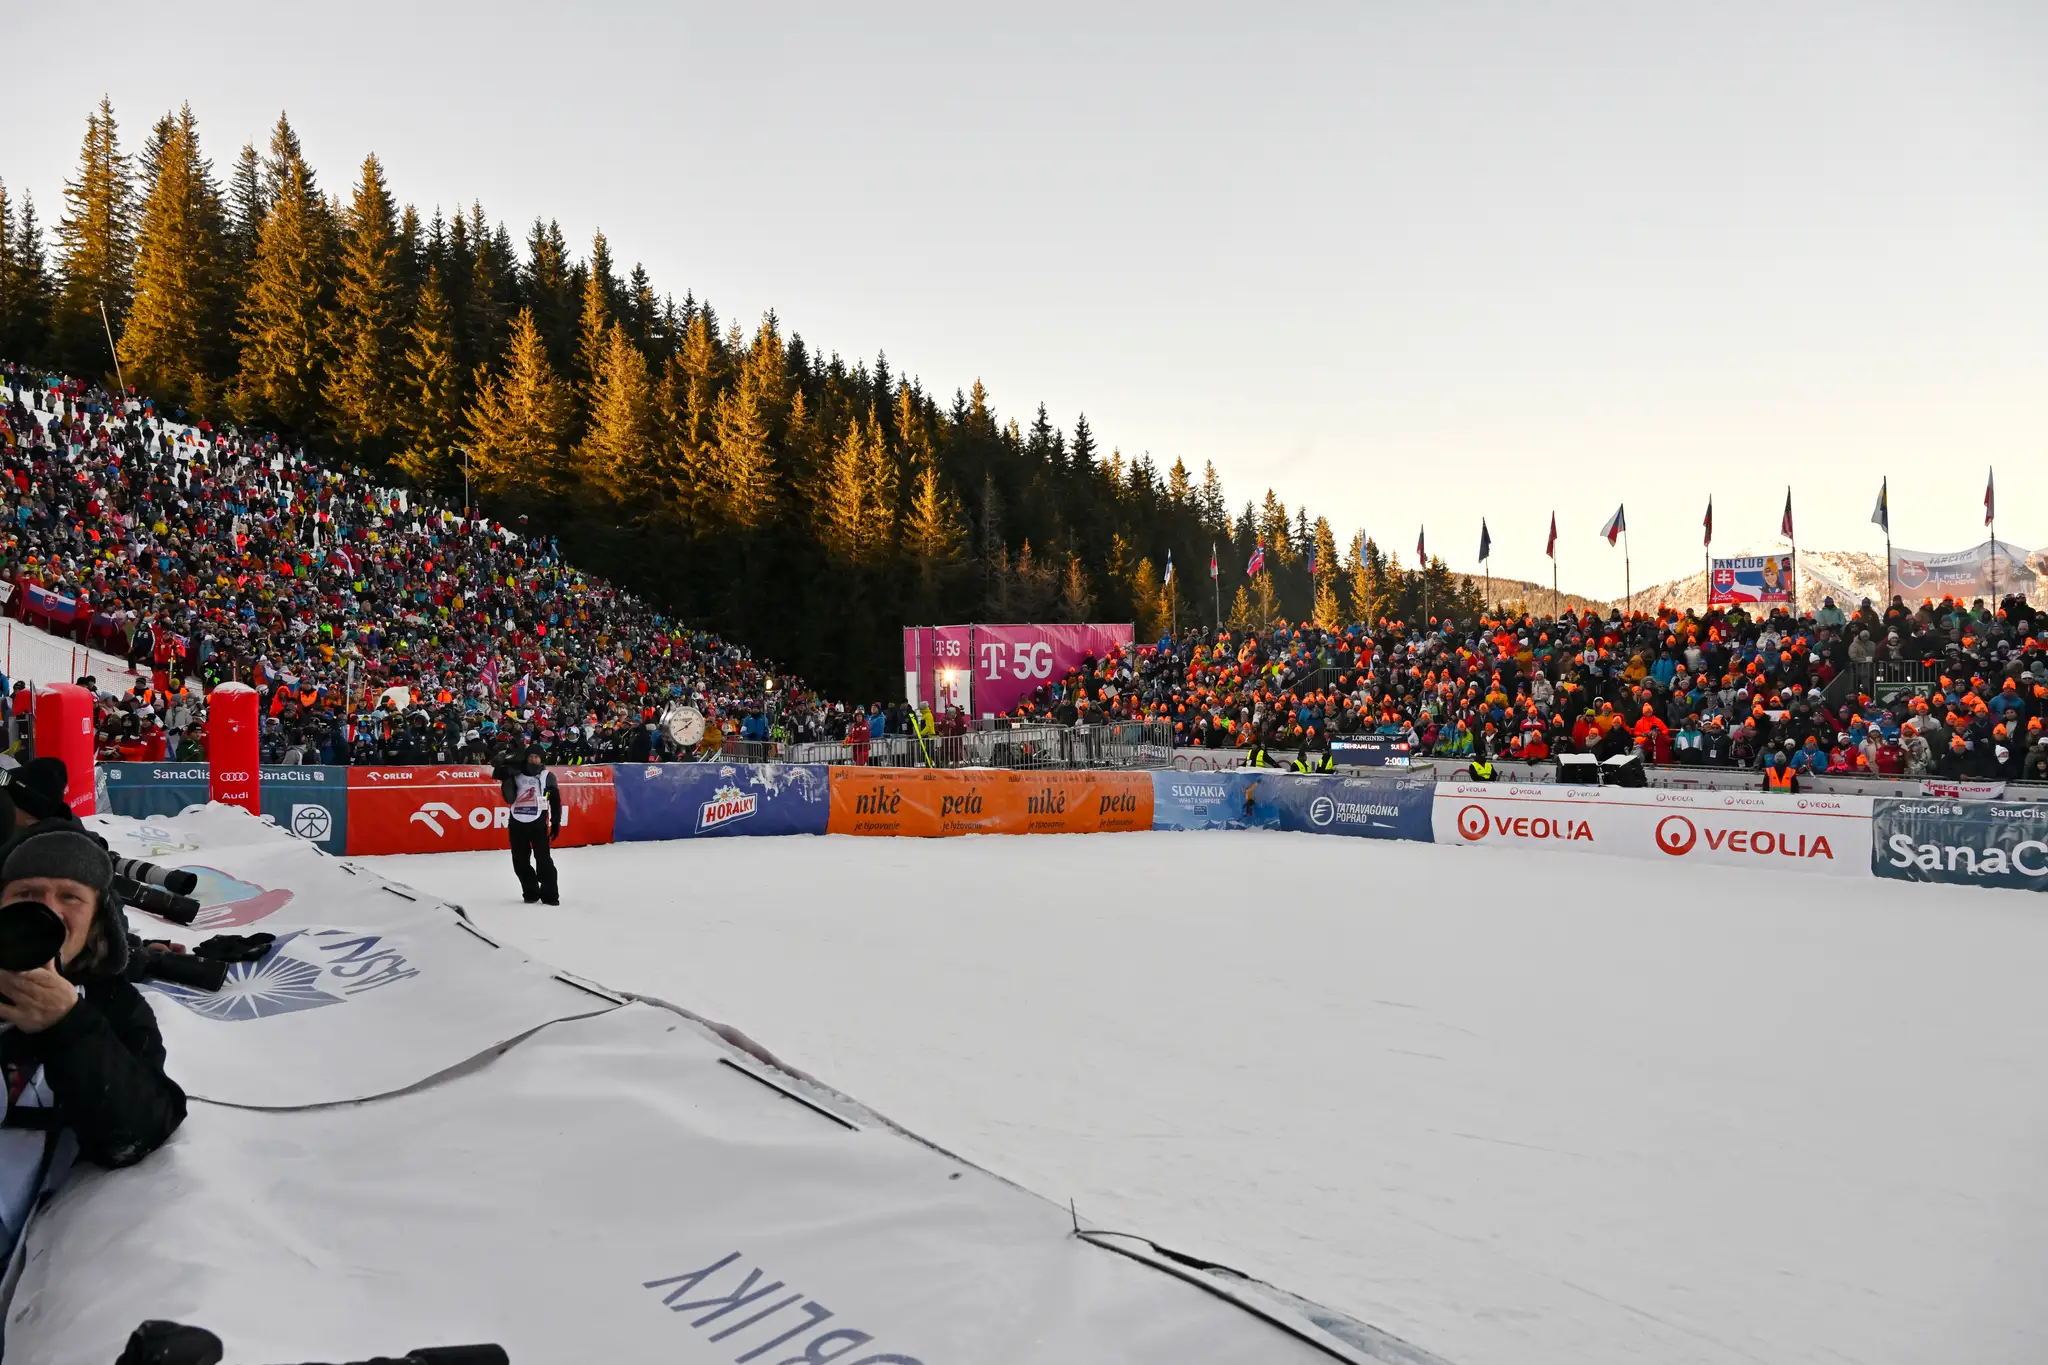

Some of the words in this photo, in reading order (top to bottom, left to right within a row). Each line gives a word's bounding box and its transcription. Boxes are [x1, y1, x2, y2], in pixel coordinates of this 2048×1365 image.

[1714, 558, 1764, 569] FANCLUB
[946, 640, 960, 656] 5G
[1013, 642, 1053, 679] 5G
[383, 772, 412, 780] ORLEN
[222, 791, 248, 800] Audi
[1172, 785, 1226, 798] SLOVAKIA
[1028, 788, 1065, 814] niké
[1736, 798, 1764, 806] VEOLIA
[706, 798, 754, 822] HORALKY
[1336, 802, 1398, 817] TATRAVAGÓNKA
[1899, 804, 1950, 815] SanaClis
[1990, 807, 2046, 819] SanaClis
[1336, 812, 1367, 824] POPRAD
[855, 822, 862, 830] je
[864, 822, 900, 830] tipovanie
[942, 822, 950, 830] je
[1494, 816, 1594, 841] VEOLIA
[1704, 828, 1834, 860] VEOLIA
[1889, 834, 2048, 876] SanaC
